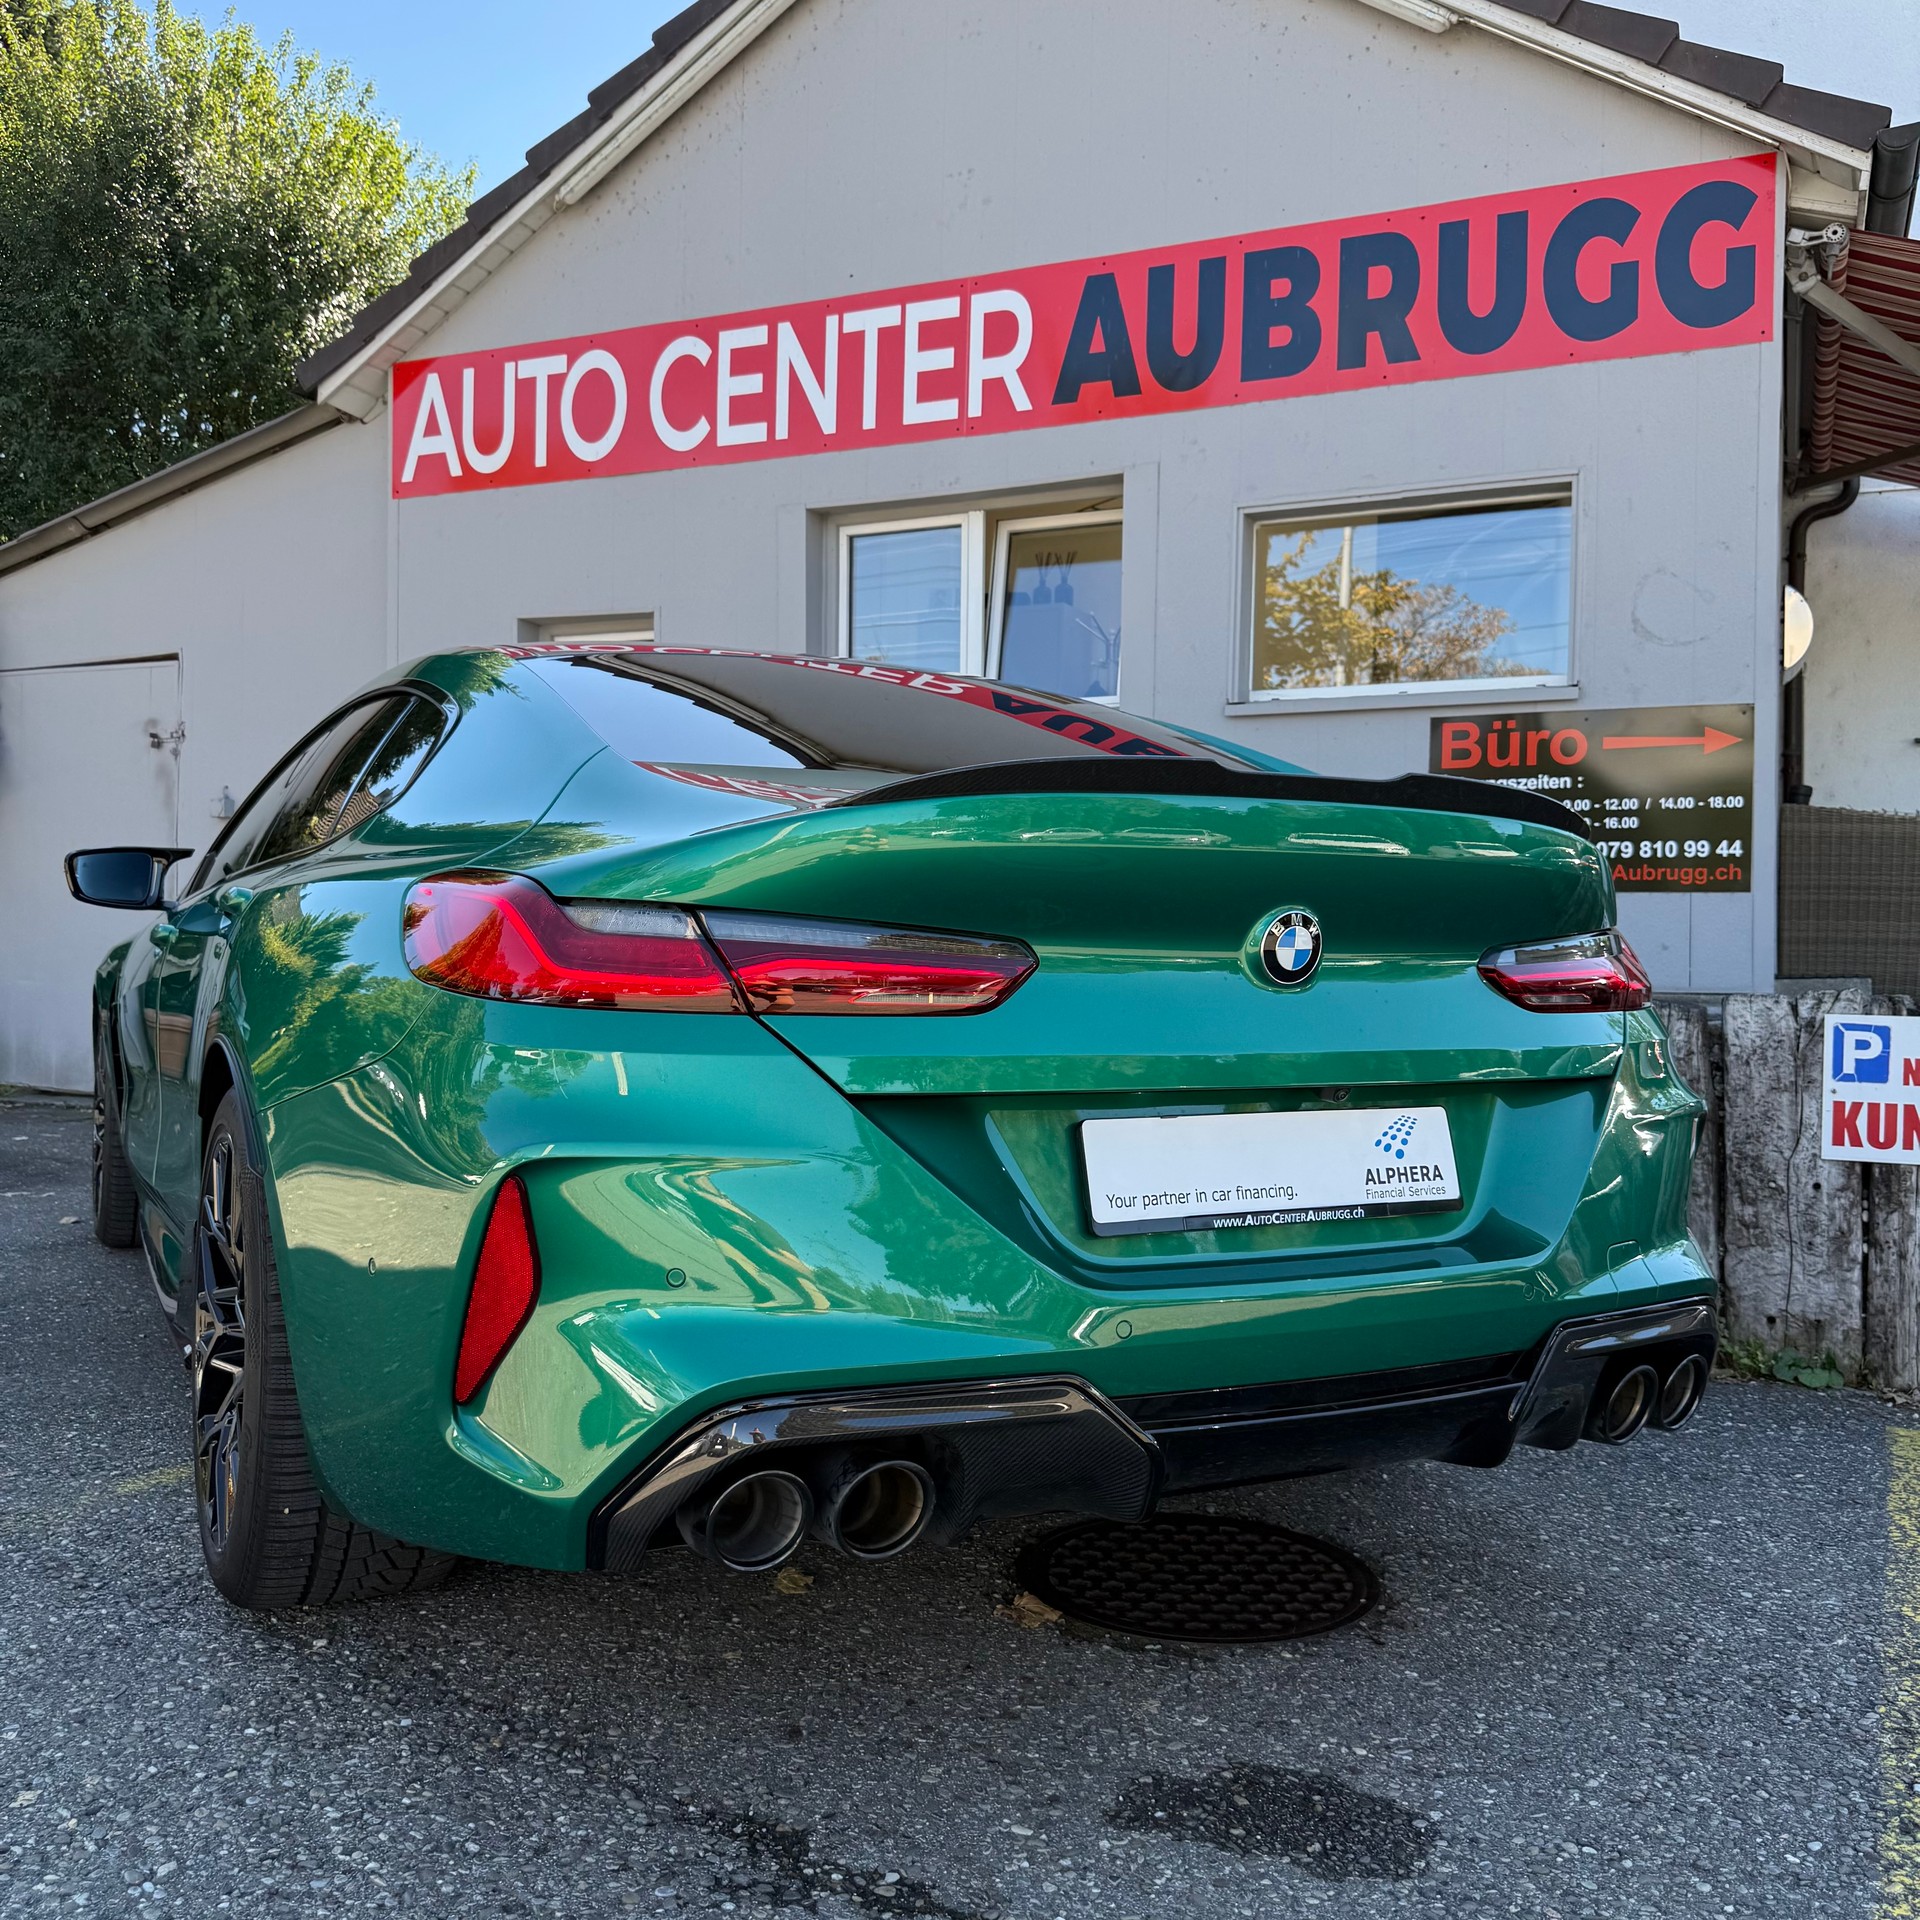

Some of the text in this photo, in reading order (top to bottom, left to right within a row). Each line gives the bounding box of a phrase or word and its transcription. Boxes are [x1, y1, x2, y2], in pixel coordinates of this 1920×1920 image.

[401, 180, 1759, 483] AUTO CENTER AUBRUGG
[1441, 720, 1588, 769] Büro
[1603, 798, 1639, 811] 12.00
[1659, 797, 1695, 810] 14.00
[1707, 796, 1744, 809] 18.00
[1603, 816, 1639, 829] 16.00
[1597, 839, 1743, 858] 079 810 99 44
[1271, 914, 1319, 937] BMW
[1843, 1031, 1883, 1074] P
[1365, 1165, 1444, 1186] ALPHERA
[1106, 1183, 1298, 1210] Your partner in car financing.
[1366, 1184, 1446, 1199] Financial Services
